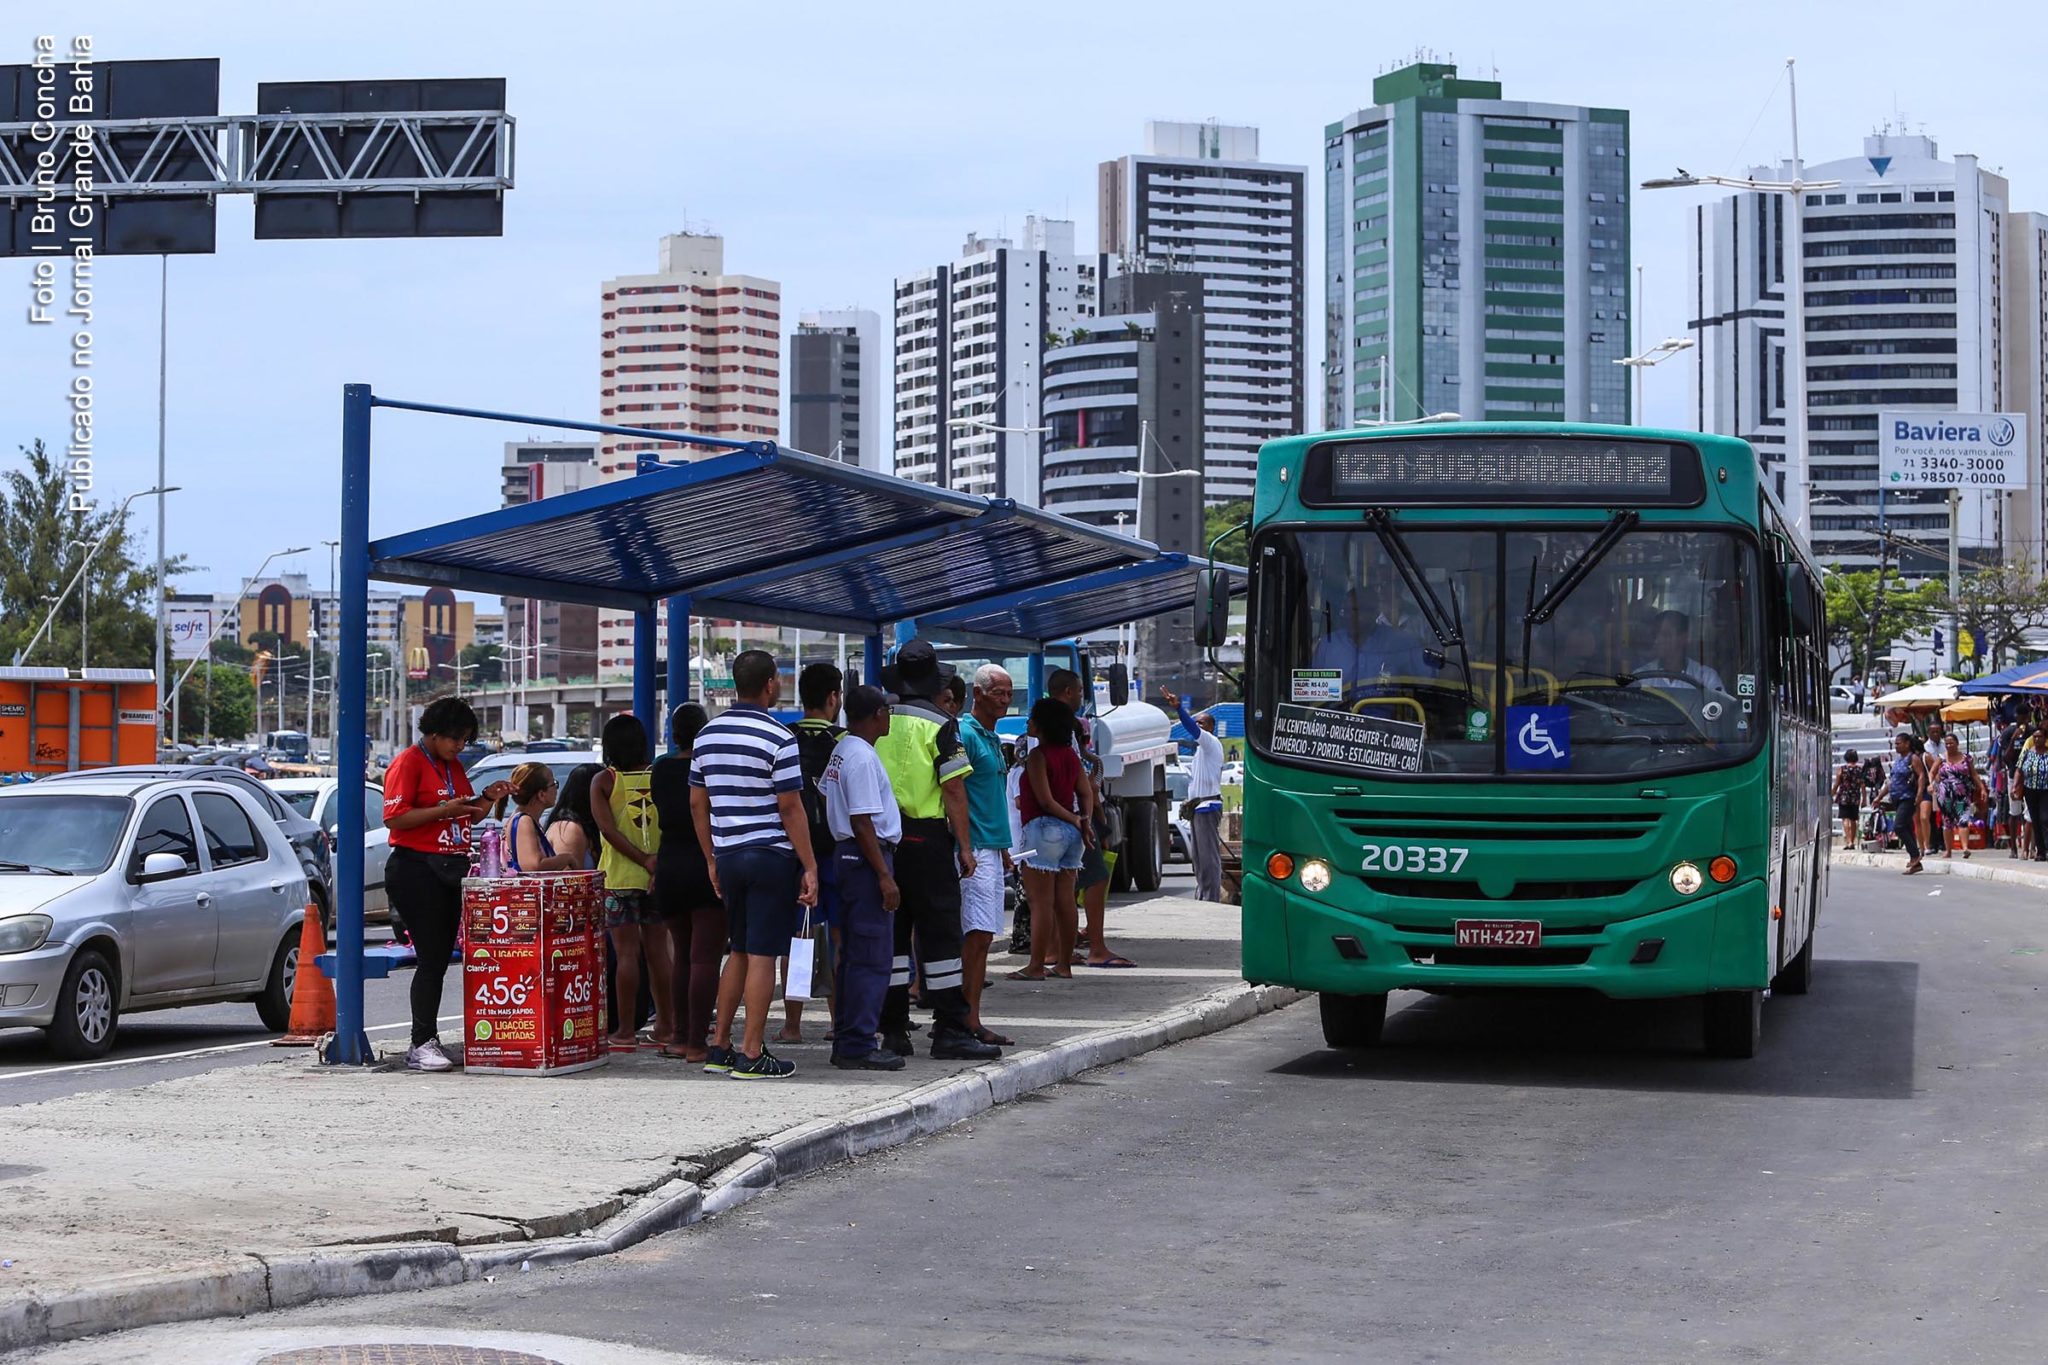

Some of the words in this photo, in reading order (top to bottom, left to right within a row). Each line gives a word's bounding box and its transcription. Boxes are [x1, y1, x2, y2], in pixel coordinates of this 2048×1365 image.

[1895, 420, 1980, 441] Baviera
[1894, 446, 1909, 454] Por
[1912, 447, 1936, 456] você,
[1940, 448, 1955, 456] nós
[1991, 448, 2016, 457] além.
[1337, 454, 1404, 480] 1231
[1416, 454, 1621, 482] SUSSUARANA
[1904, 459, 1915, 468] 71
[1921, 457, 2004, 470] 3340-3000
[1904, 473, 1915, 481] 71
[1921, 472, 2005, 484] 98507-0000
[1739, 684, 1754, 694] G3
[1345, 715, 1365, 723] 1231
[1277, 718, 1286, 732] AV.
[1287, 719, 1326, 737] CENTENÁRIO
[1329, 724, 1354, 741] ORIXÁS
[1355, 728, 1380, 746] CENTER
[1383, 733, 1390, 748] C.
[1391, 735, 1418, 752] GRANDE
[1273, 735, 1308, 754] COMÉRCIO
[1311, 742, 1317, 755] 7
[1317, 742, 1345, 759] PORTAS
[1401, 756, 1417, 771] CAB
[438, 827, 470, 846] 4.G
[1361, 845, 1469, 873] 20337
[475, 976, 527, 1005] 4.5G
[564, 975, 590, 1003] 4.5G
[495, 1018, 535, 1032] LIGAÇÕES
[496, 1032, 535, 1040] ILIMITADAS
